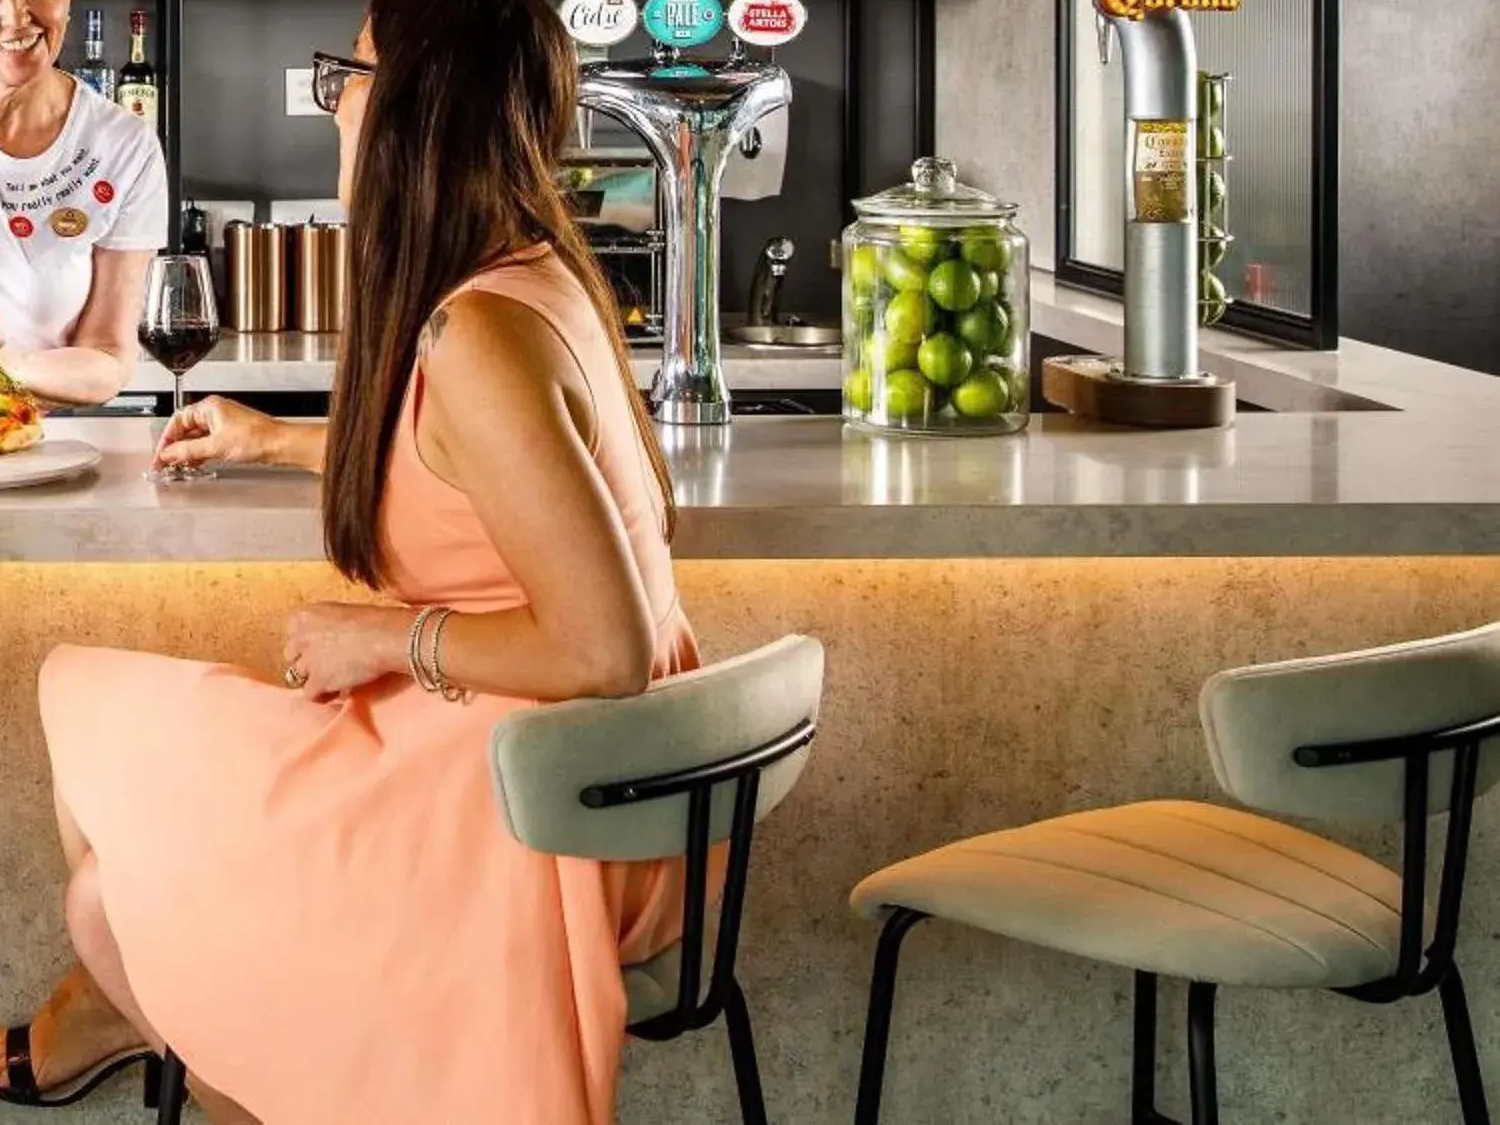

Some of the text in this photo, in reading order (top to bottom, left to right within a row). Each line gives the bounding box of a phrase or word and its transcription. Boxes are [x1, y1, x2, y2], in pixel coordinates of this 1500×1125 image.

[666, 1, 700, 27] PALE
[749, 8, 787, 18] STELLA
[748, 18, 787, 28] ARTOIS
